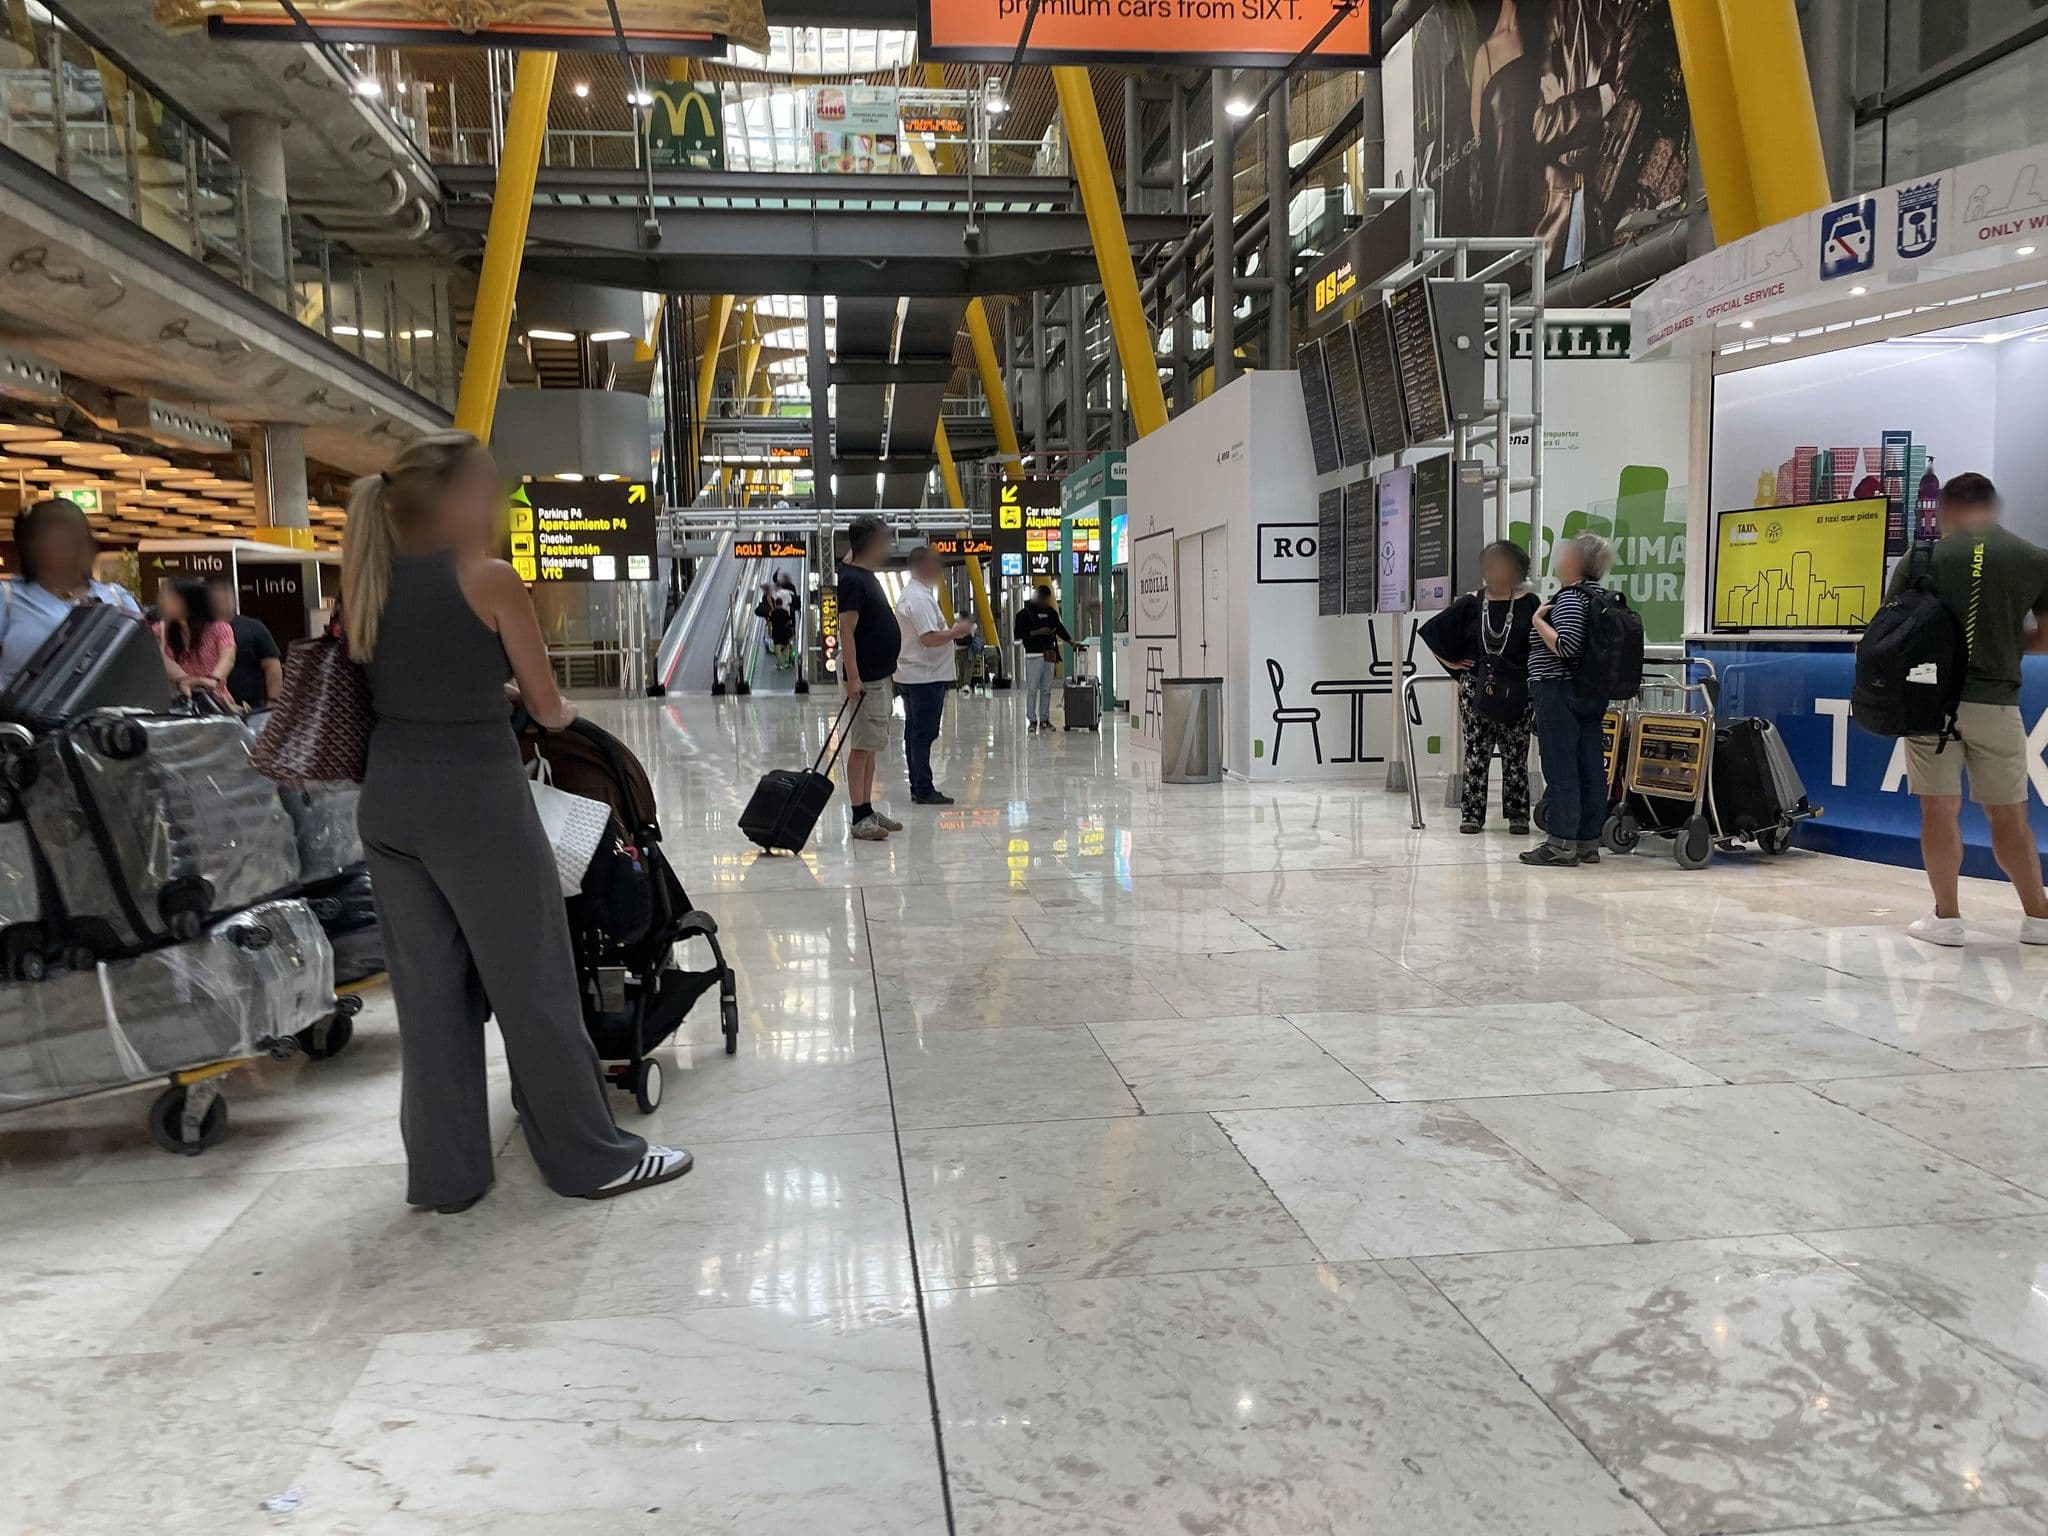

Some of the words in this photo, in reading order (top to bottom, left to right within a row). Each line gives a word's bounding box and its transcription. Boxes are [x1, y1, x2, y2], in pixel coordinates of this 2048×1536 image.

[1117, 0, 1170, 17] cars
[1177, 0, 1235, 19] from
[1242, 0, 1302, 20] SIXT.
[1979, 219, 2024, 240] ONLY
[1674, 316, 1694, 331] RATES
[1706, 299, 1741, 318] OFFICIAL
[1744, 282, 1785, 305] SERVICE
[538, 508, 569, 519] Parking
[571, 508, 582, 518] P4
[1026, 507, 1039, 516] Car
[1041, 507, 1061, 516] rental
[1817, 516, 1825, 524] El
[1825, 515, 1839, 523] taxi
[1841, 515, 1855, 523] que
[1857, 512, 1878, 521] pides
[539, 519, 611, 532] Aparcamiento
[613, 518, 627, 530] P4
[540, 533, 573, 544] Check-in
[540, 544, 600, 555] Facturación
[735, 544, 763, 556] AQUI
[193, 555, 223, 571] info
[541, 557, 588, 569] Ridesharing
[1972, 542, 1985, 578] PÁDEL
[265, 578, 297, 594] info
[1140, 576, 1168, 594] RODILLA
